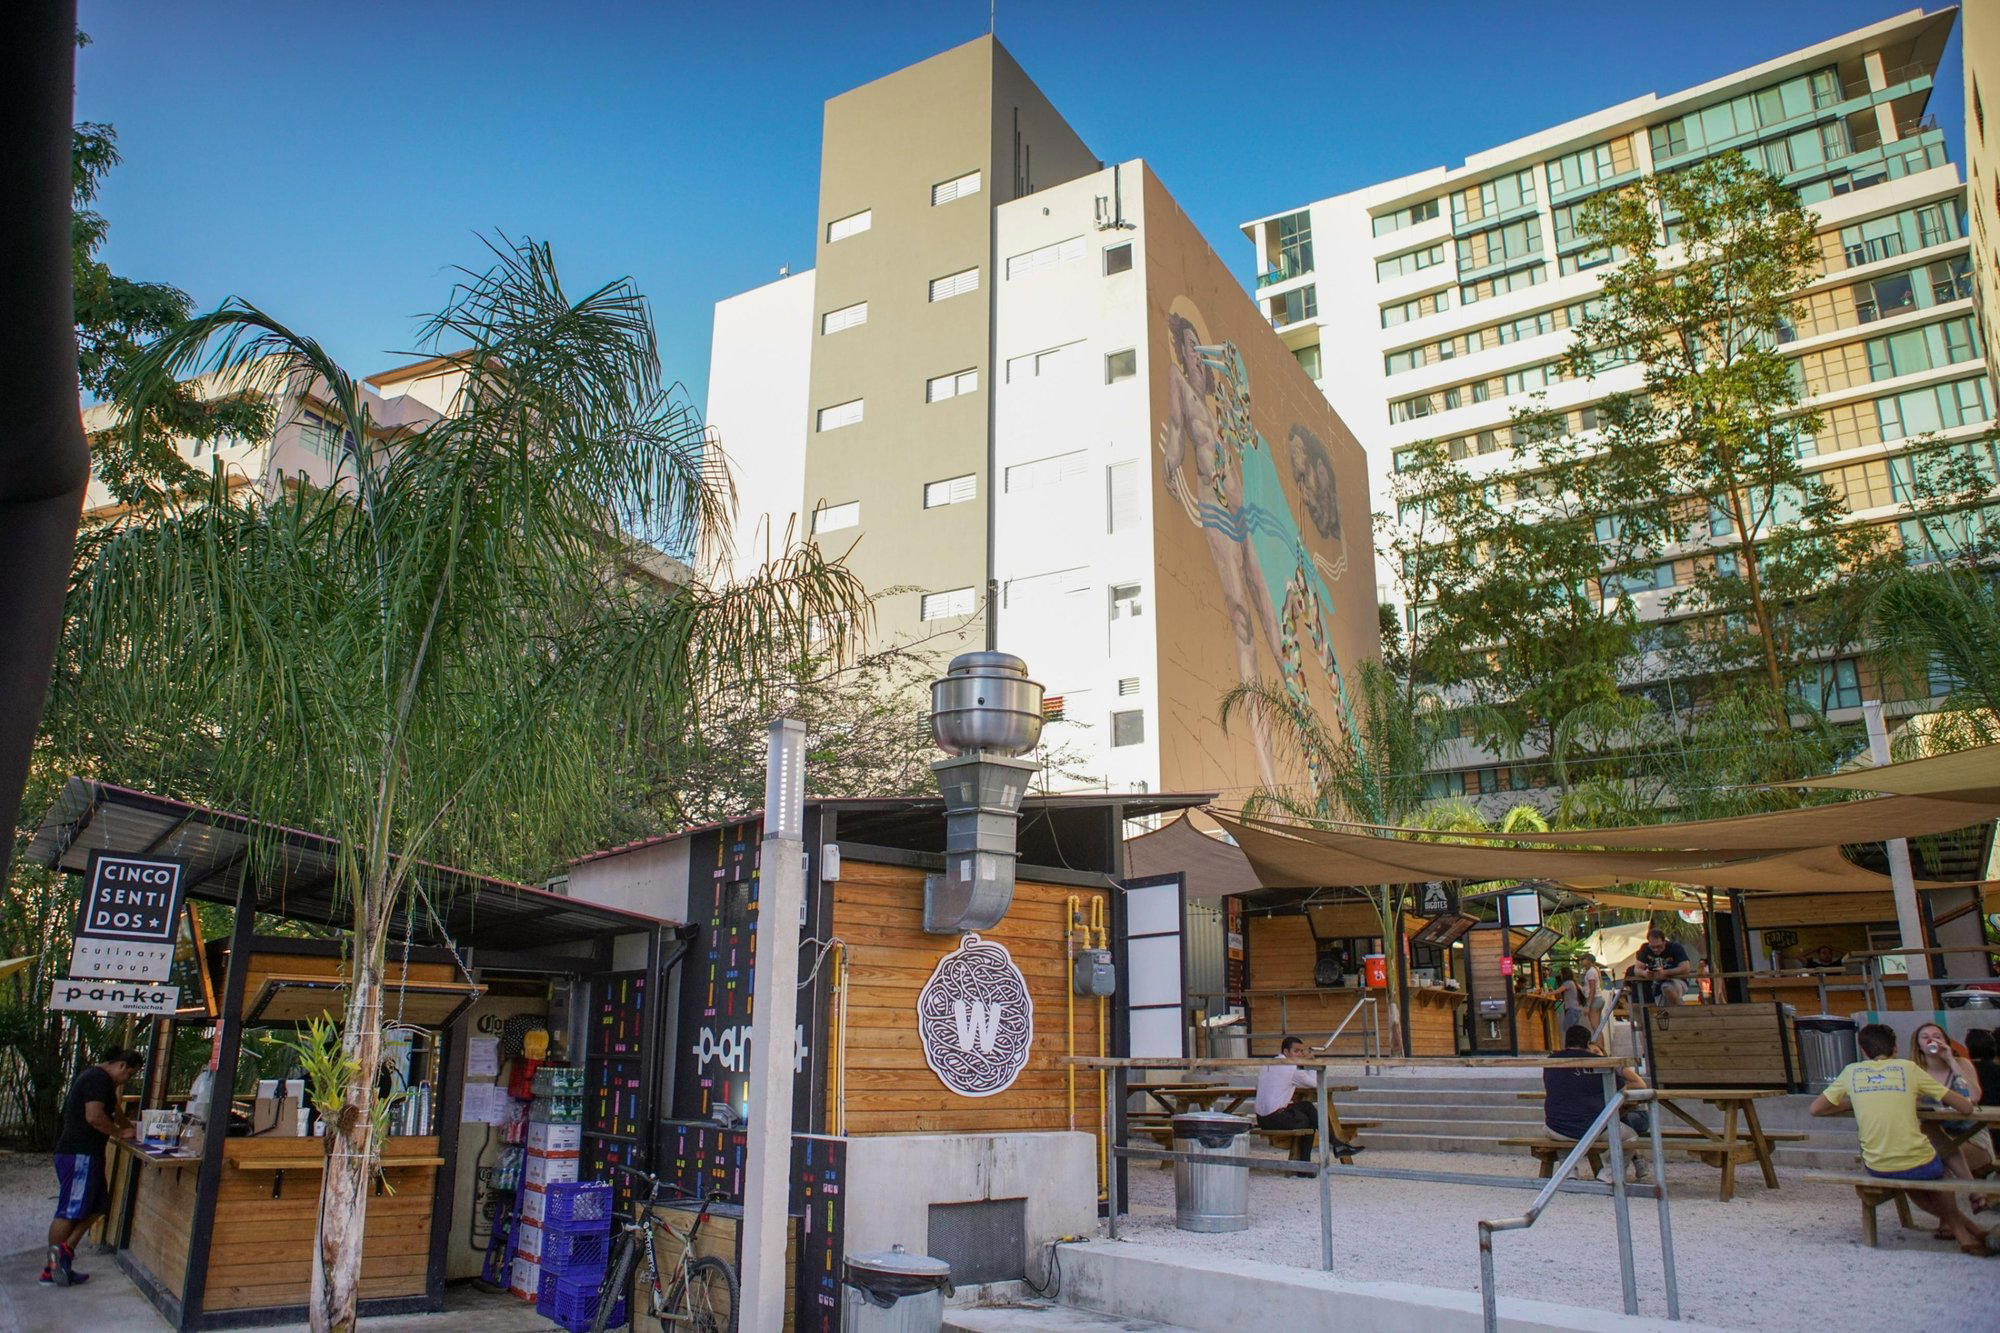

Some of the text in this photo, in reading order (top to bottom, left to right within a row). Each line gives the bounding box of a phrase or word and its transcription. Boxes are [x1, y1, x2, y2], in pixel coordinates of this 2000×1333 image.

[104, 865, 170, 885] CINCO
[100, 888, 166, 908] SENTI
[1424, 901, 1448, 910] BIGOTES
[96, 911, 143, 928] DOS
[81, 946, 167, 960] culinary
[93, 962, 150, 974] group
[65, 987, 167, 1004] panka
[954, 999, 1003, 1054] W
[696, 1024, 805, 1076] pana
